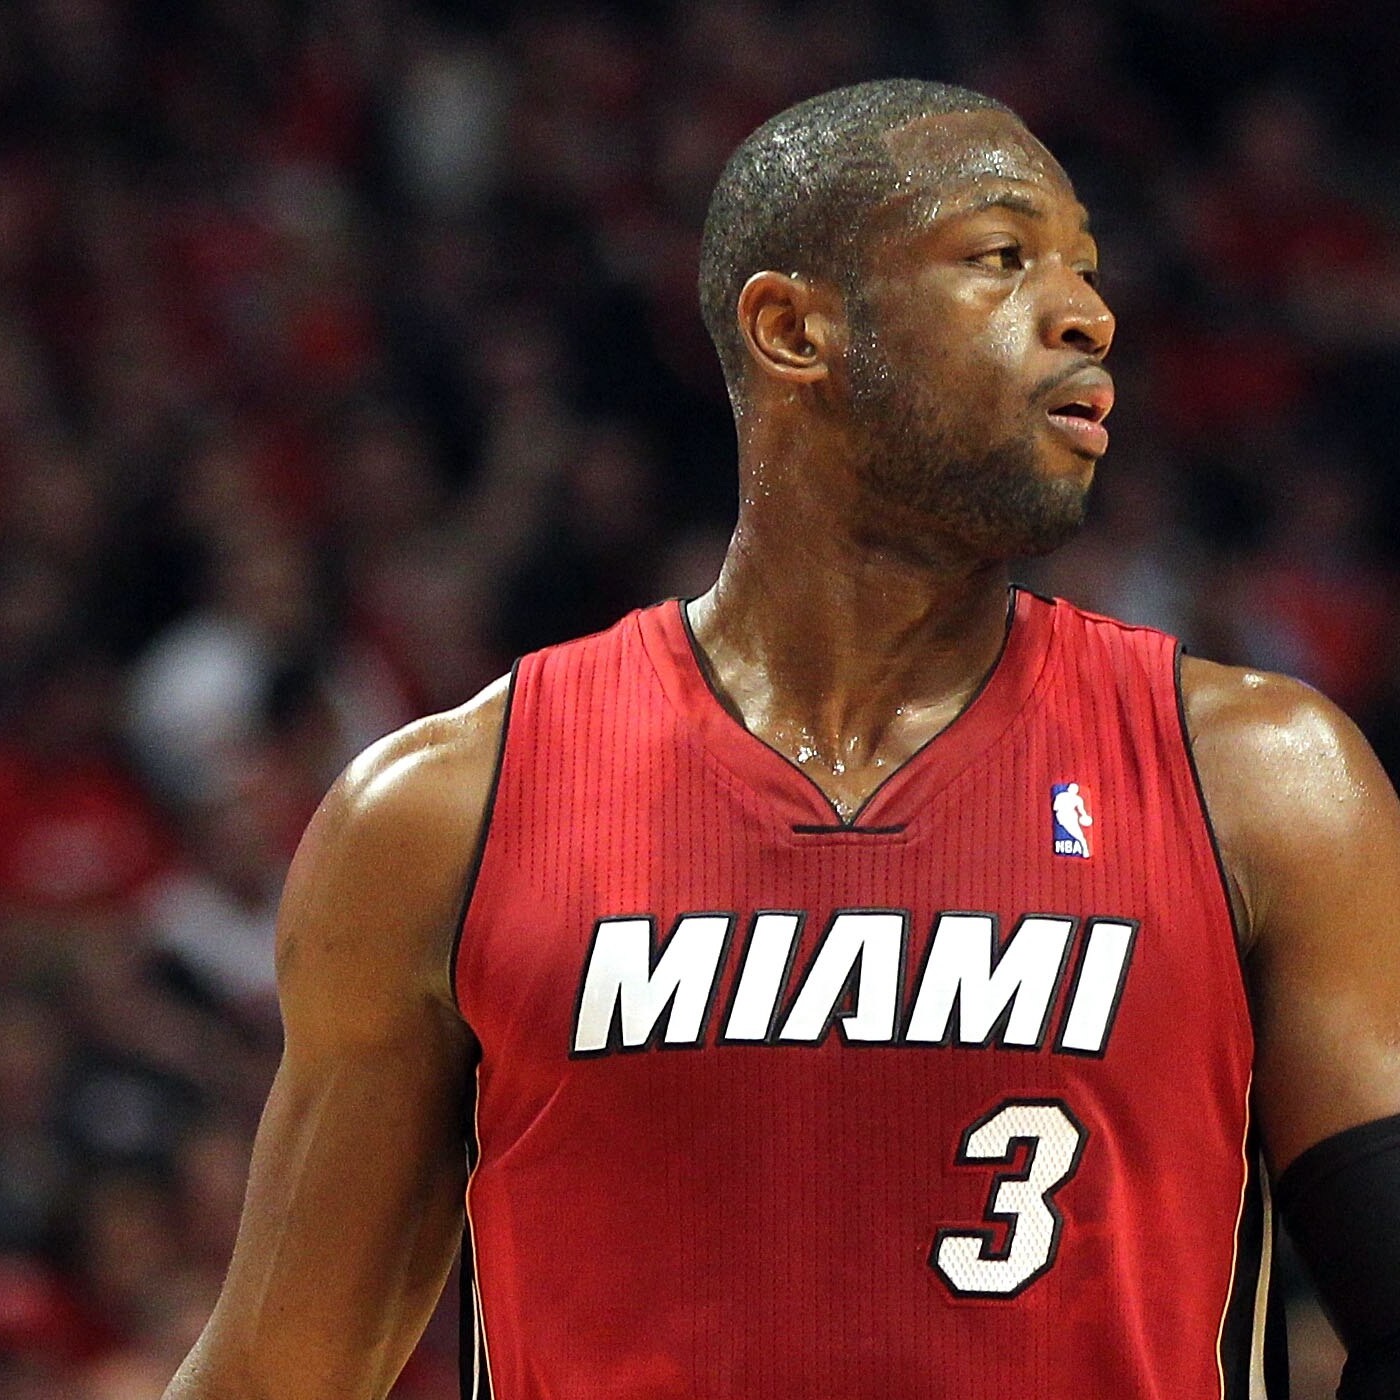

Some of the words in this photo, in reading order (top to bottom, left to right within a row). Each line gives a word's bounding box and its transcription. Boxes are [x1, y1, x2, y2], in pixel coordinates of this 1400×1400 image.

[1055, 840, 1082, 854] NBA
[570, 909, 1139, 1058] MIAMI
[930, 1098, 1088, 1298] 3
